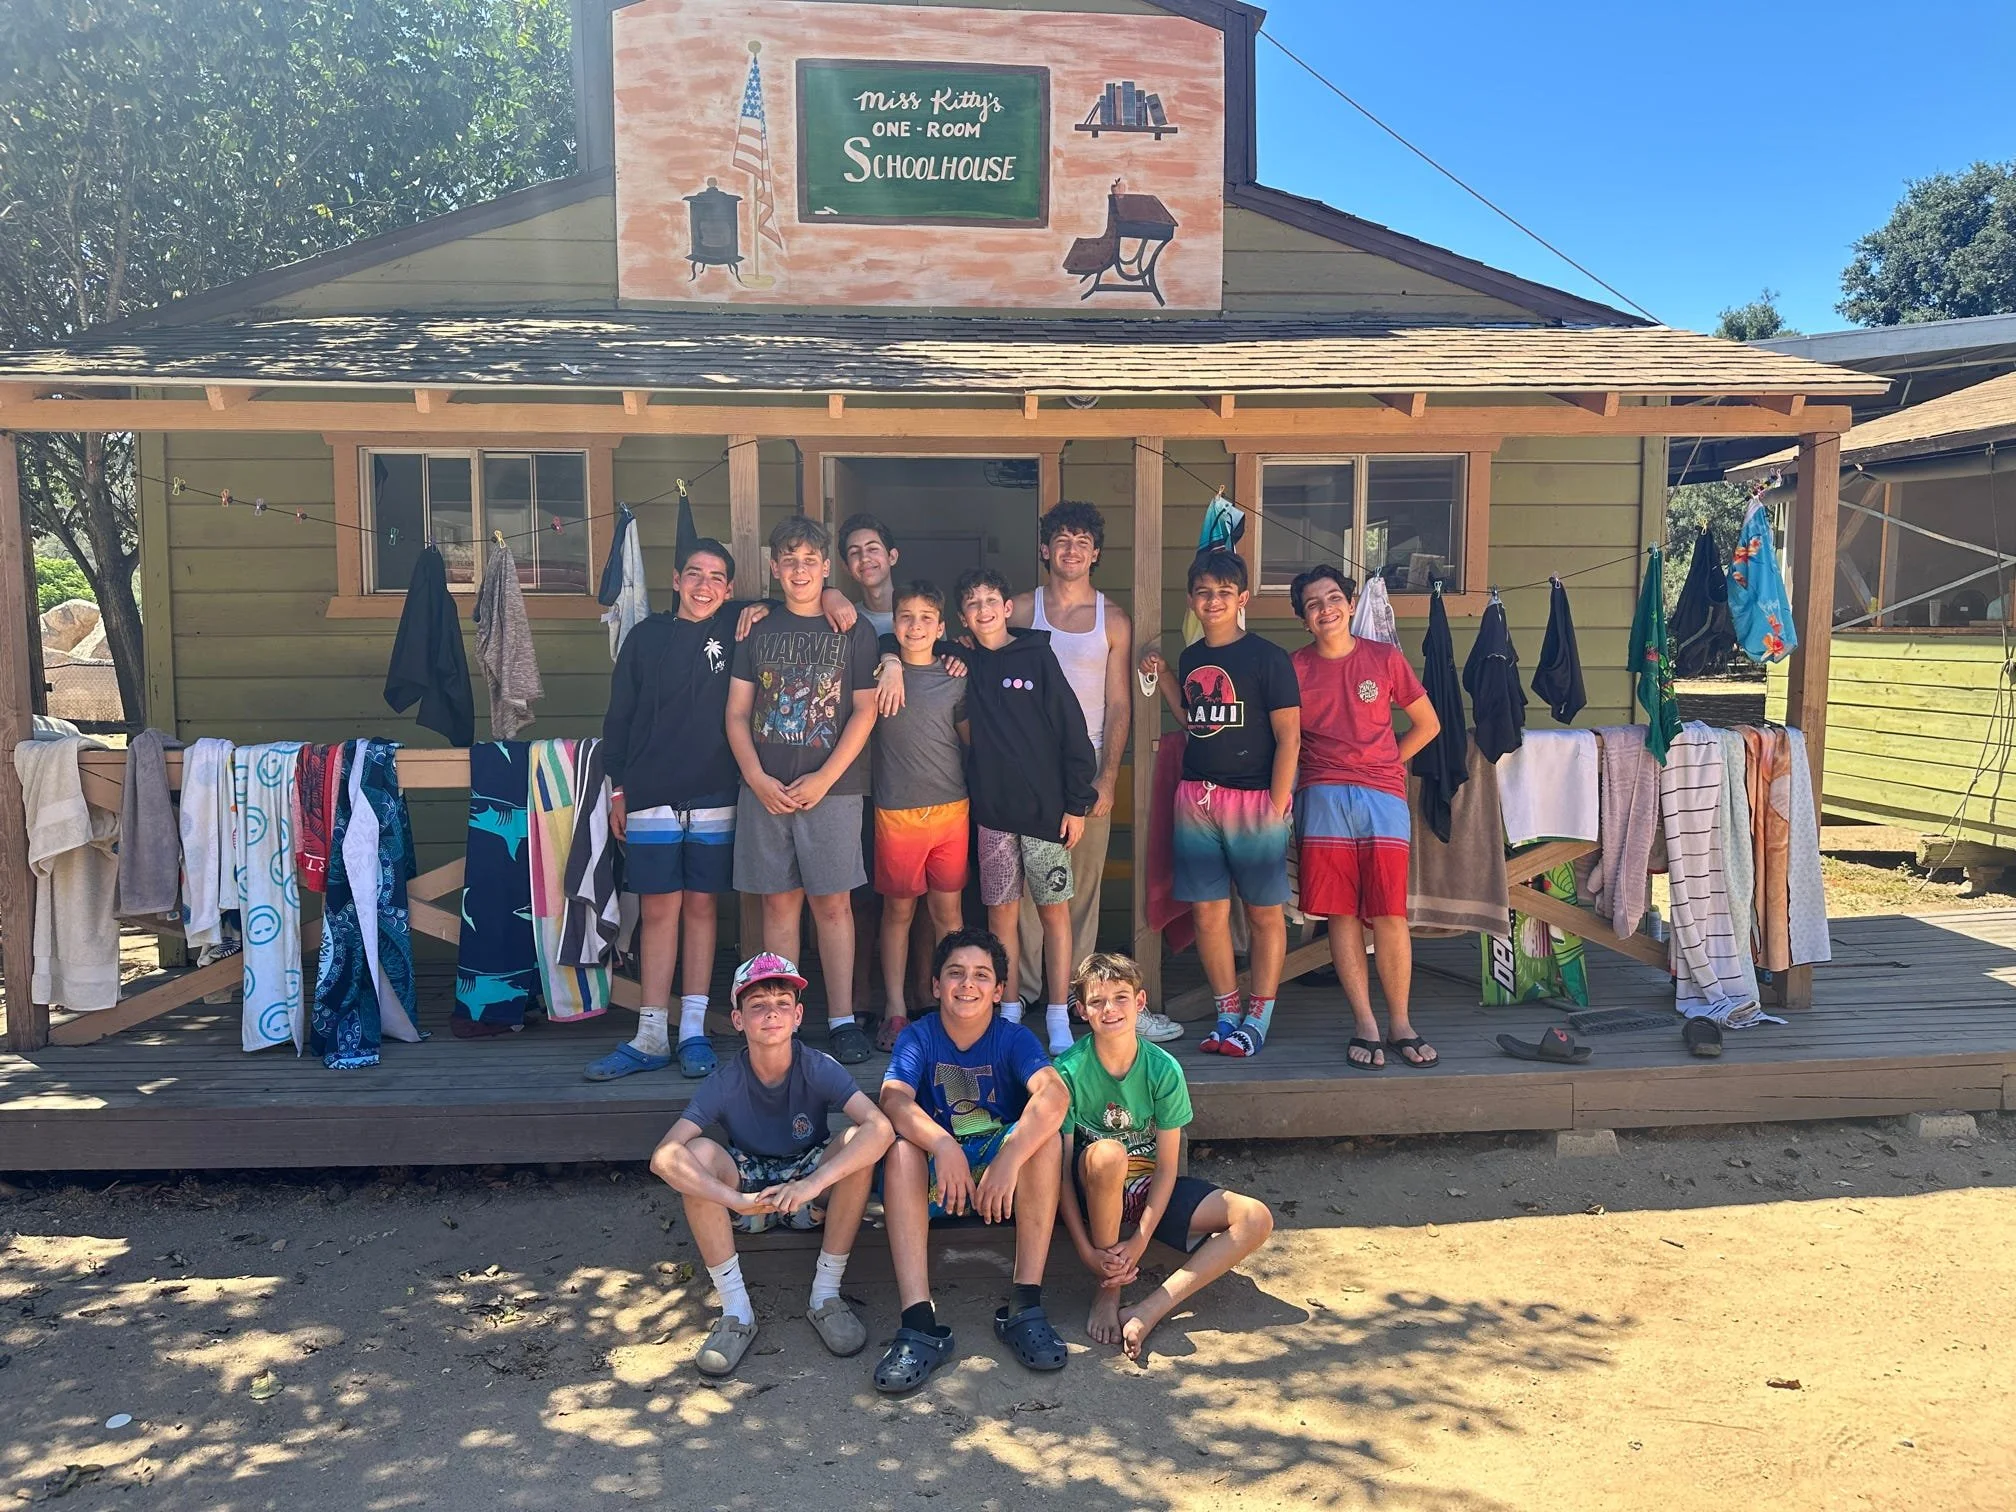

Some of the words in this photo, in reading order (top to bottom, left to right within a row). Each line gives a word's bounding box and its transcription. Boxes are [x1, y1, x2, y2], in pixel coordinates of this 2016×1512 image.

[853, 90, 922, 111] Miss
[930, 87, 1005, 122] Kitty's
[843, 136, 1017, 183] SCHOOLHOUSE
[755, 632, 848, 670] MARVEL
